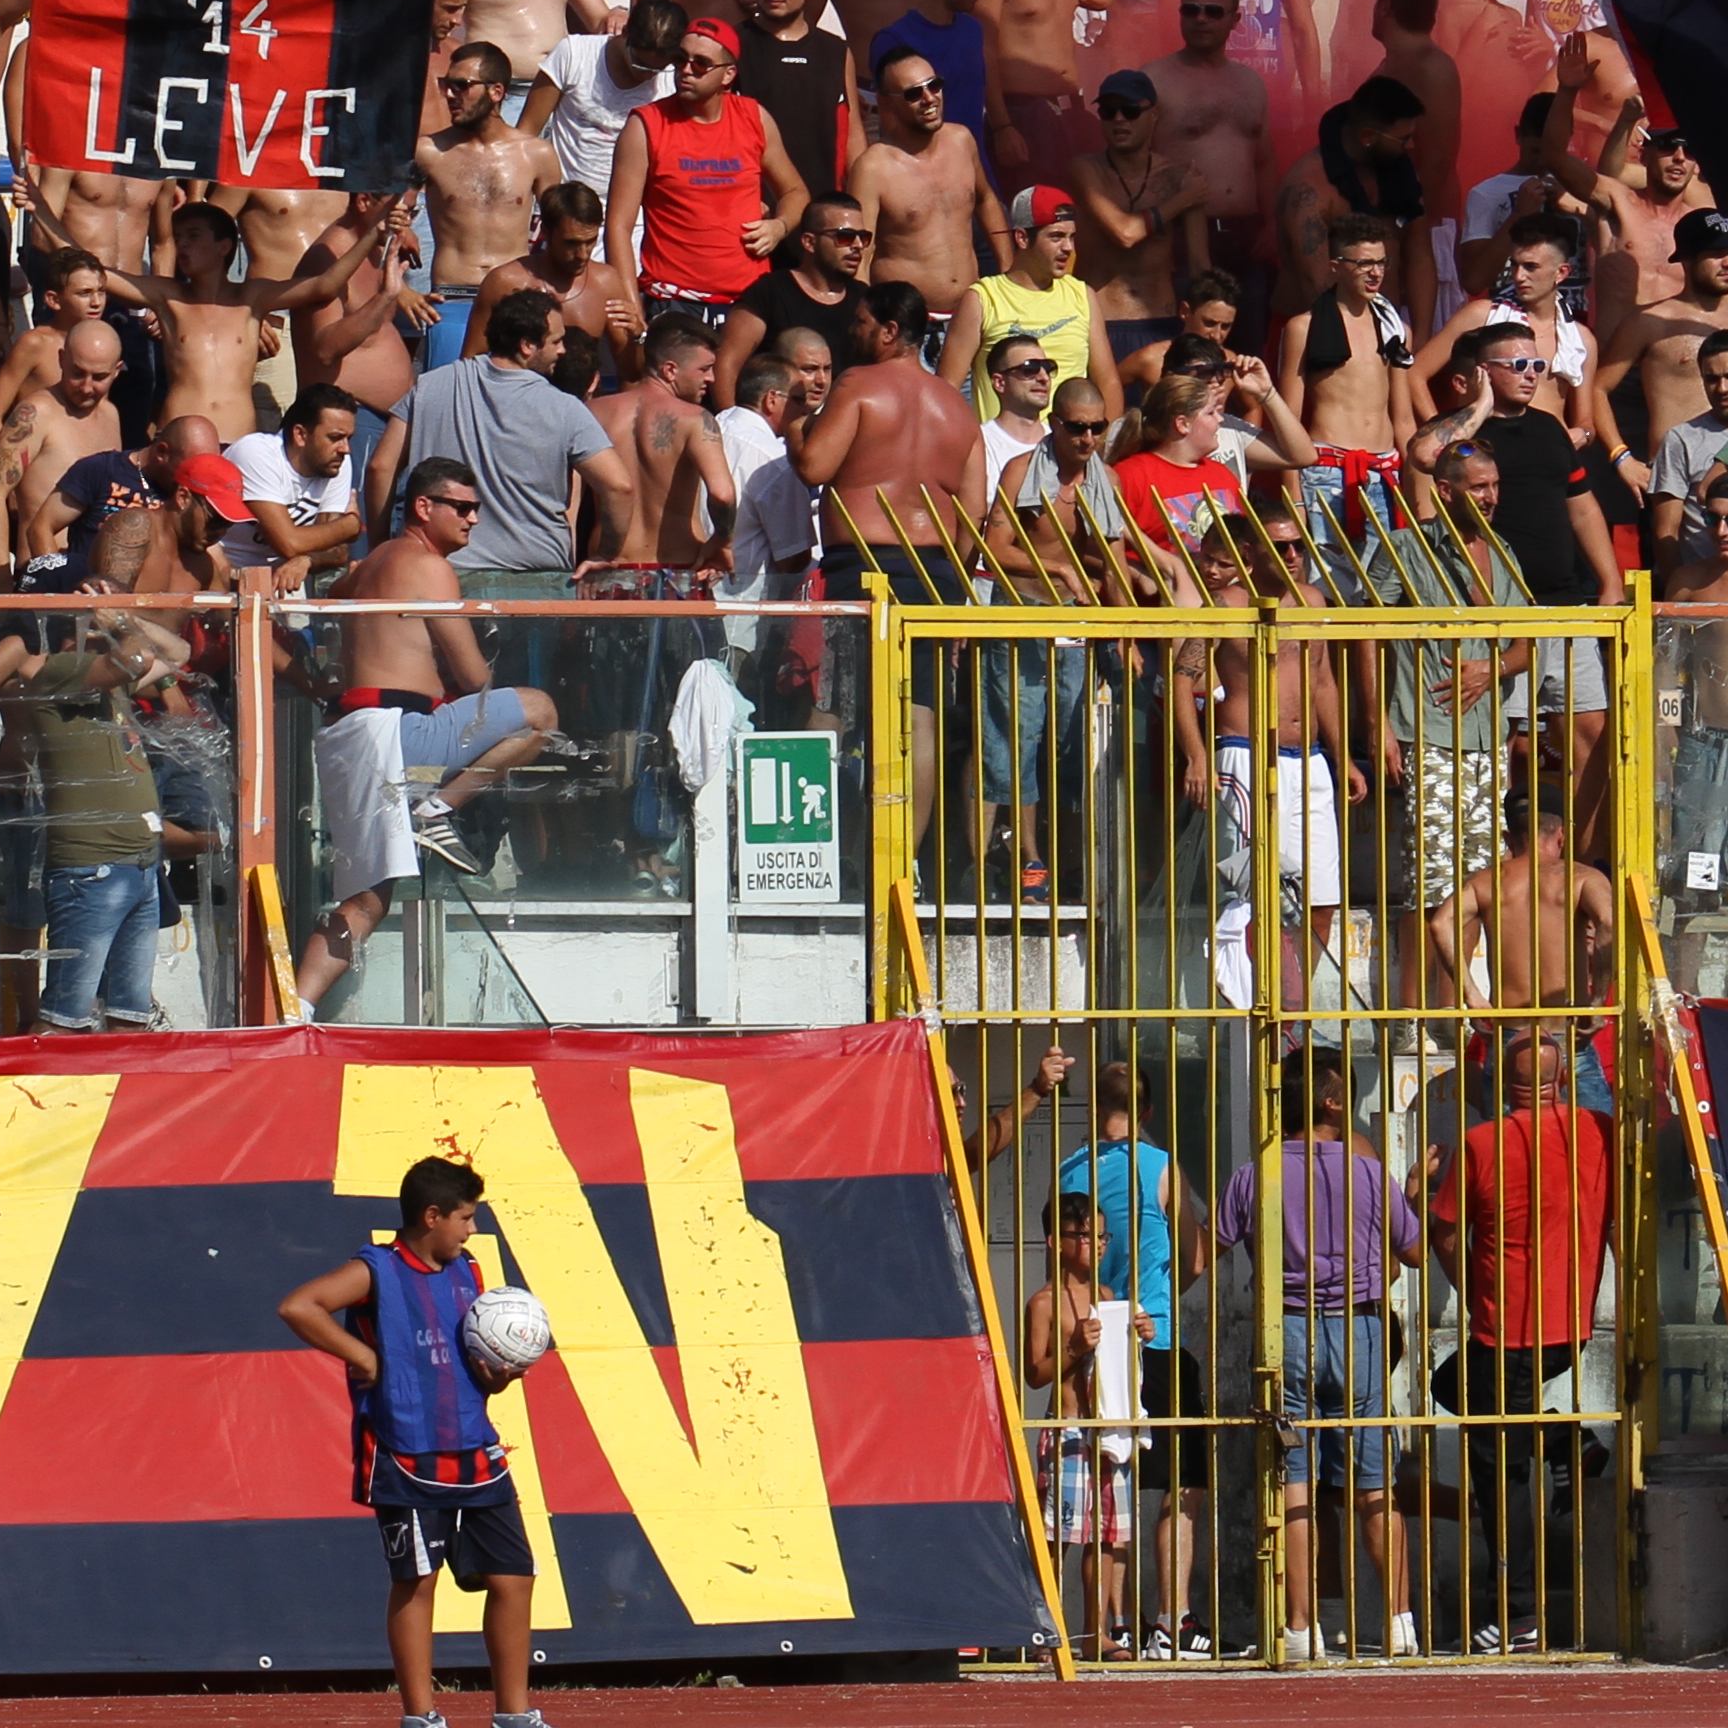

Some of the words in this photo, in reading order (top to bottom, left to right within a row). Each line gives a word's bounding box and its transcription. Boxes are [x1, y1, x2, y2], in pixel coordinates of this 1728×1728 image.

[85, 67, 356, 178] LEVE
[757, 852, 805, 869] USCITA
[809, 851, 822, 868] DI
[747, 872, 833, 890] EMERGENZA
